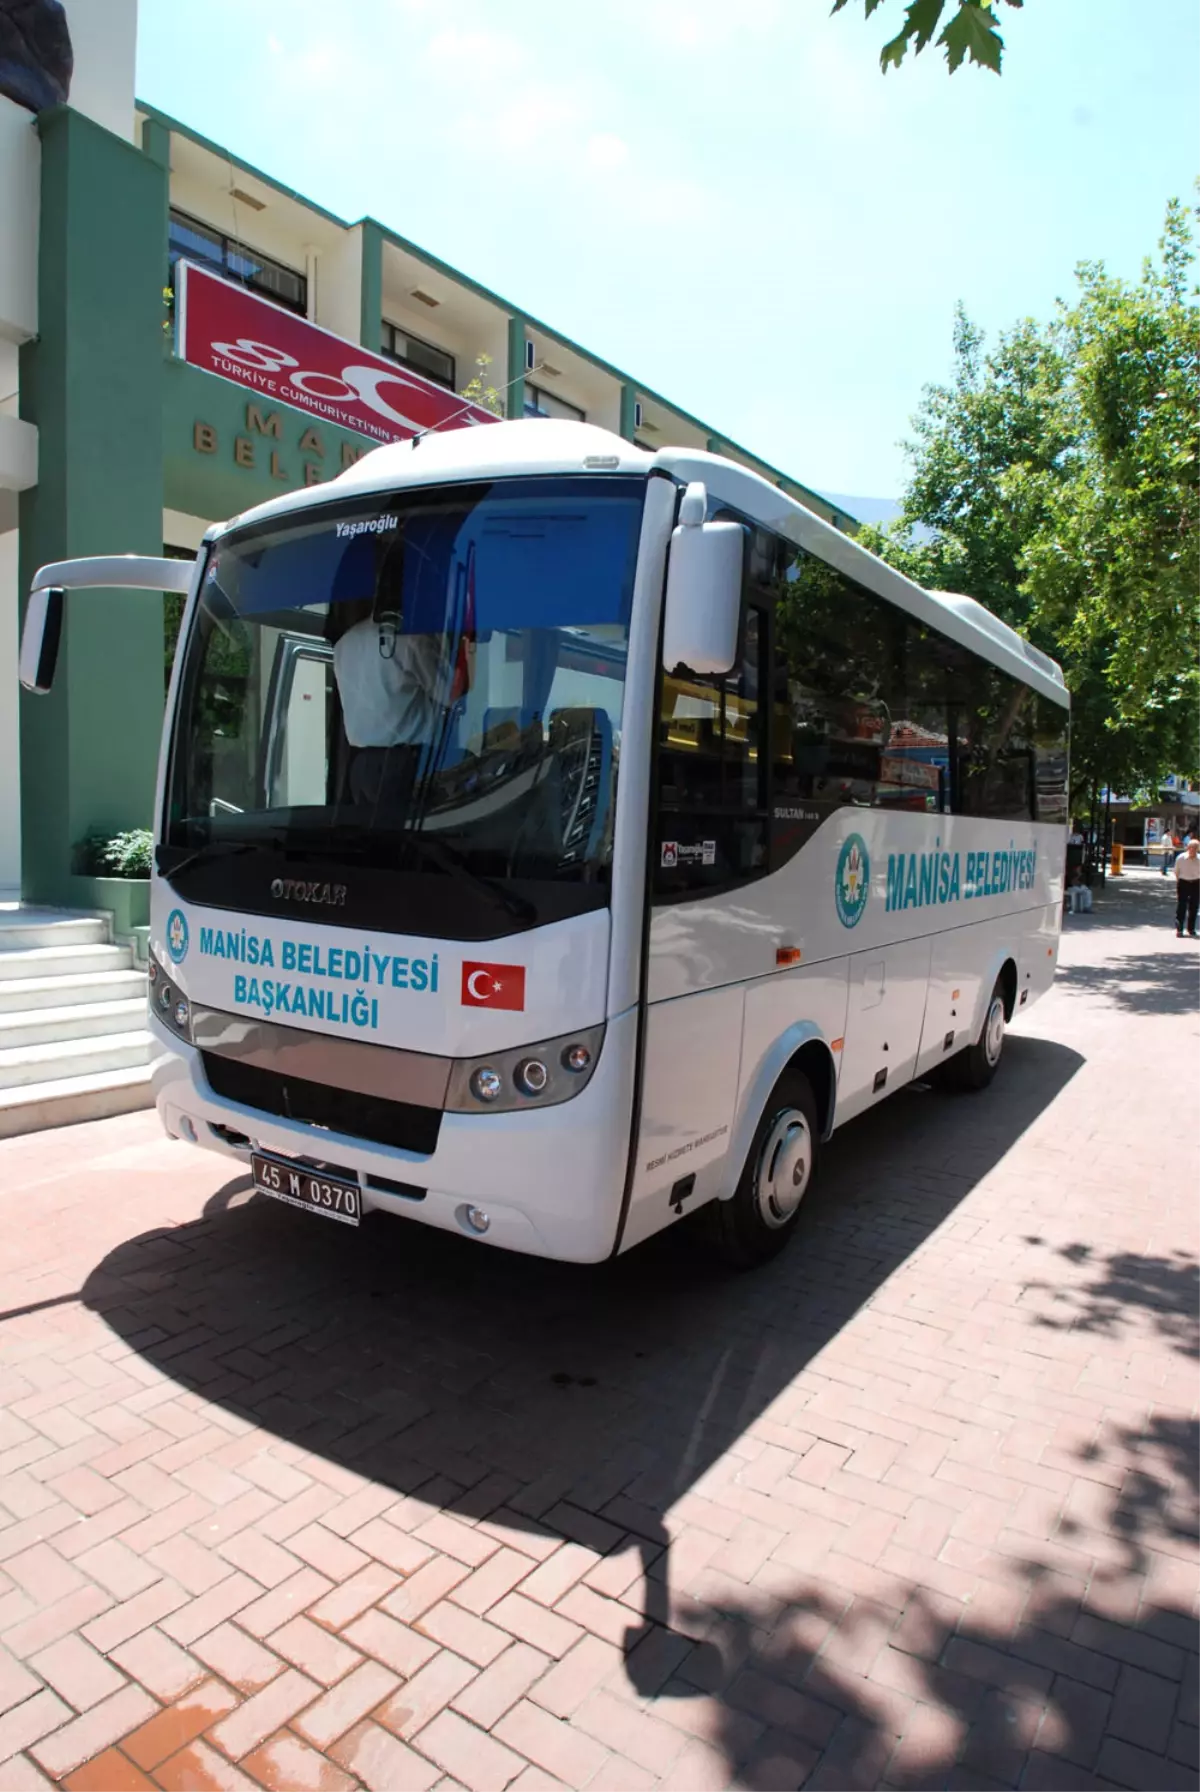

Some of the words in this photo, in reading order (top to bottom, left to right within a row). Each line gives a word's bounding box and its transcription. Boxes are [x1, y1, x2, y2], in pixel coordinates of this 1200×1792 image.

[210, 355, 277, 392] TÜRKİYE
[279, 384, 391, 442] CUMHURİYETİ'NİN
[336, 514, 399, 540] Yaşaroğlu
[774, 806, 805, 820] SULTAN
[270, 878, 347, 906] OTOKAR
[885, 836, 960, 913] MANİSA
[963, 838, 1038, 900] BELEDİYESİ
[199, 926, 275, 970] MANİSA
[281, 940, 439, 993] BELEDİYESİ
[234, 975, 379, 1029] BAŞKANLIĞI
[262, 1164, 280, 1188] 45
[310, 1180, 356, 1214] 0370
